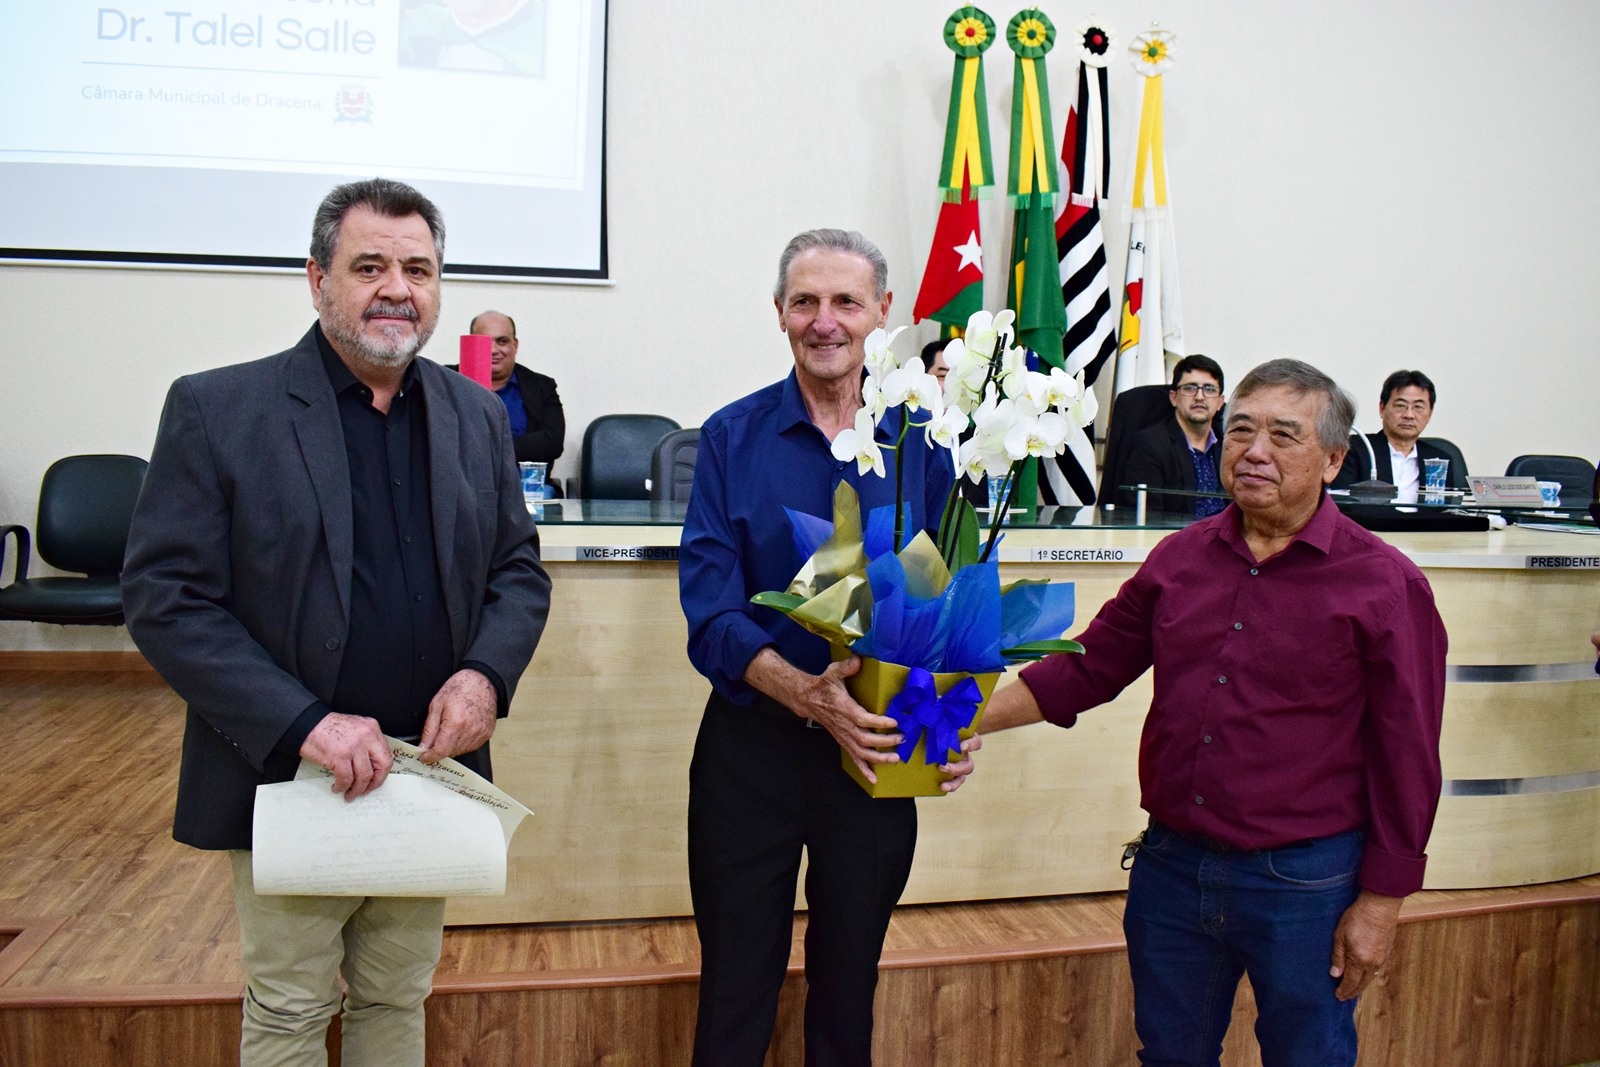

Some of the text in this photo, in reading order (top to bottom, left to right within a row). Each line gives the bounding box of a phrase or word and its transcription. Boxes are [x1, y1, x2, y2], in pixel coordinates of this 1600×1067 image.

[96, 7, 376, 55] Dr. Talel Salle
[81, 84, 322, 110] Câmara Municipal de Dracena
[1037, 548, 1124, 561] 1º SECRETÁRIO
[1531, 557, 1600, 567] PRESIDENTE
